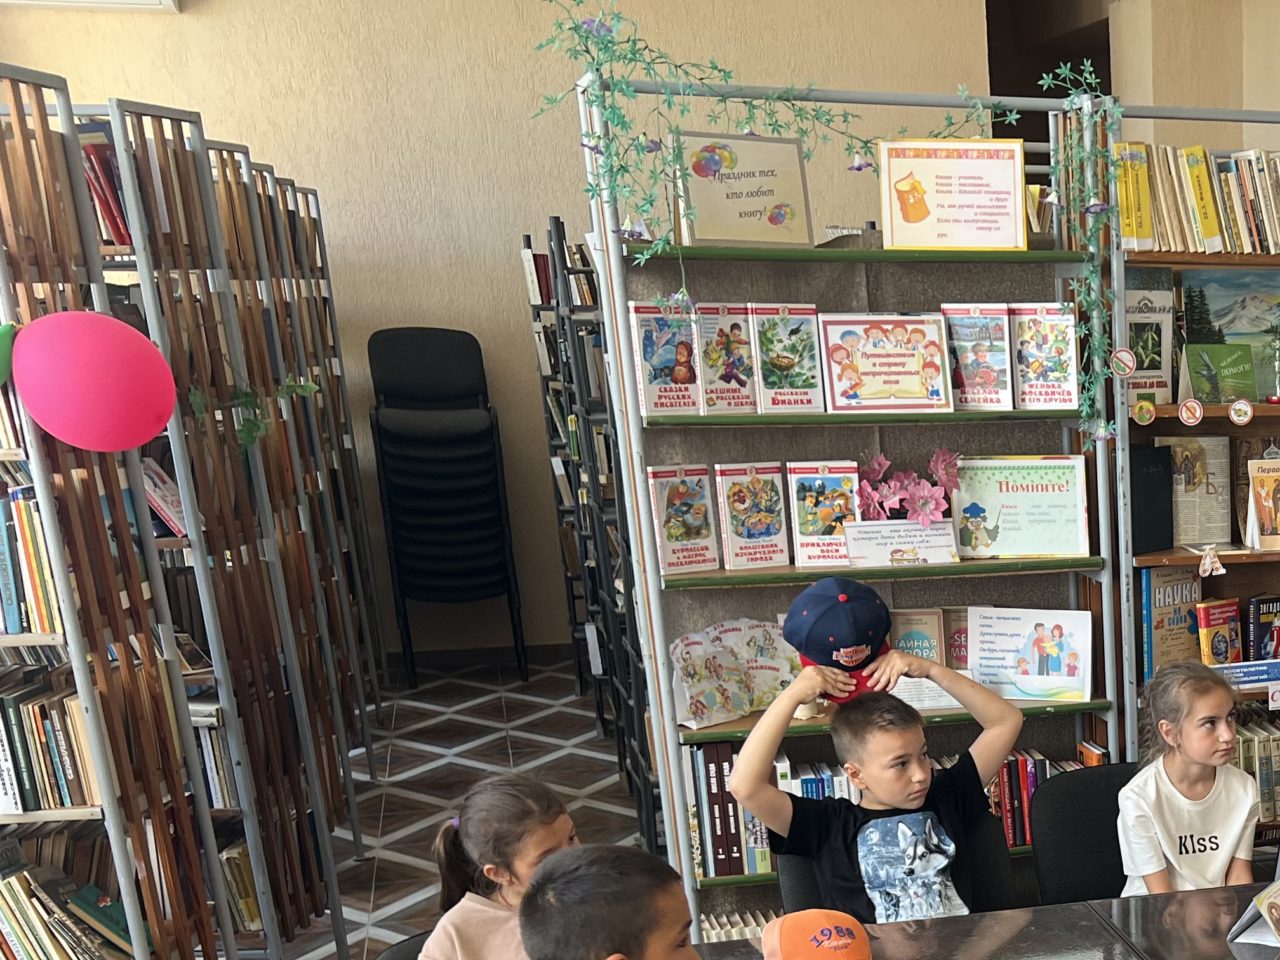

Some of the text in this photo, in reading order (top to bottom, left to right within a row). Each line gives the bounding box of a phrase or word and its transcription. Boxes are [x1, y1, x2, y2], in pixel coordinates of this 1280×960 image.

[714, 169, 778, 184] Праздник тех,
[745, 186, 774, 198] любит
[739, 206, 767, 221] книгу!
[997, 480, 1070, 493] Помните!
[1155, 582, 1199, 608] НАУКА
[895, 639, 937, 648] ТАЙНАЯ
[810, 925, 856, 948] 1988
